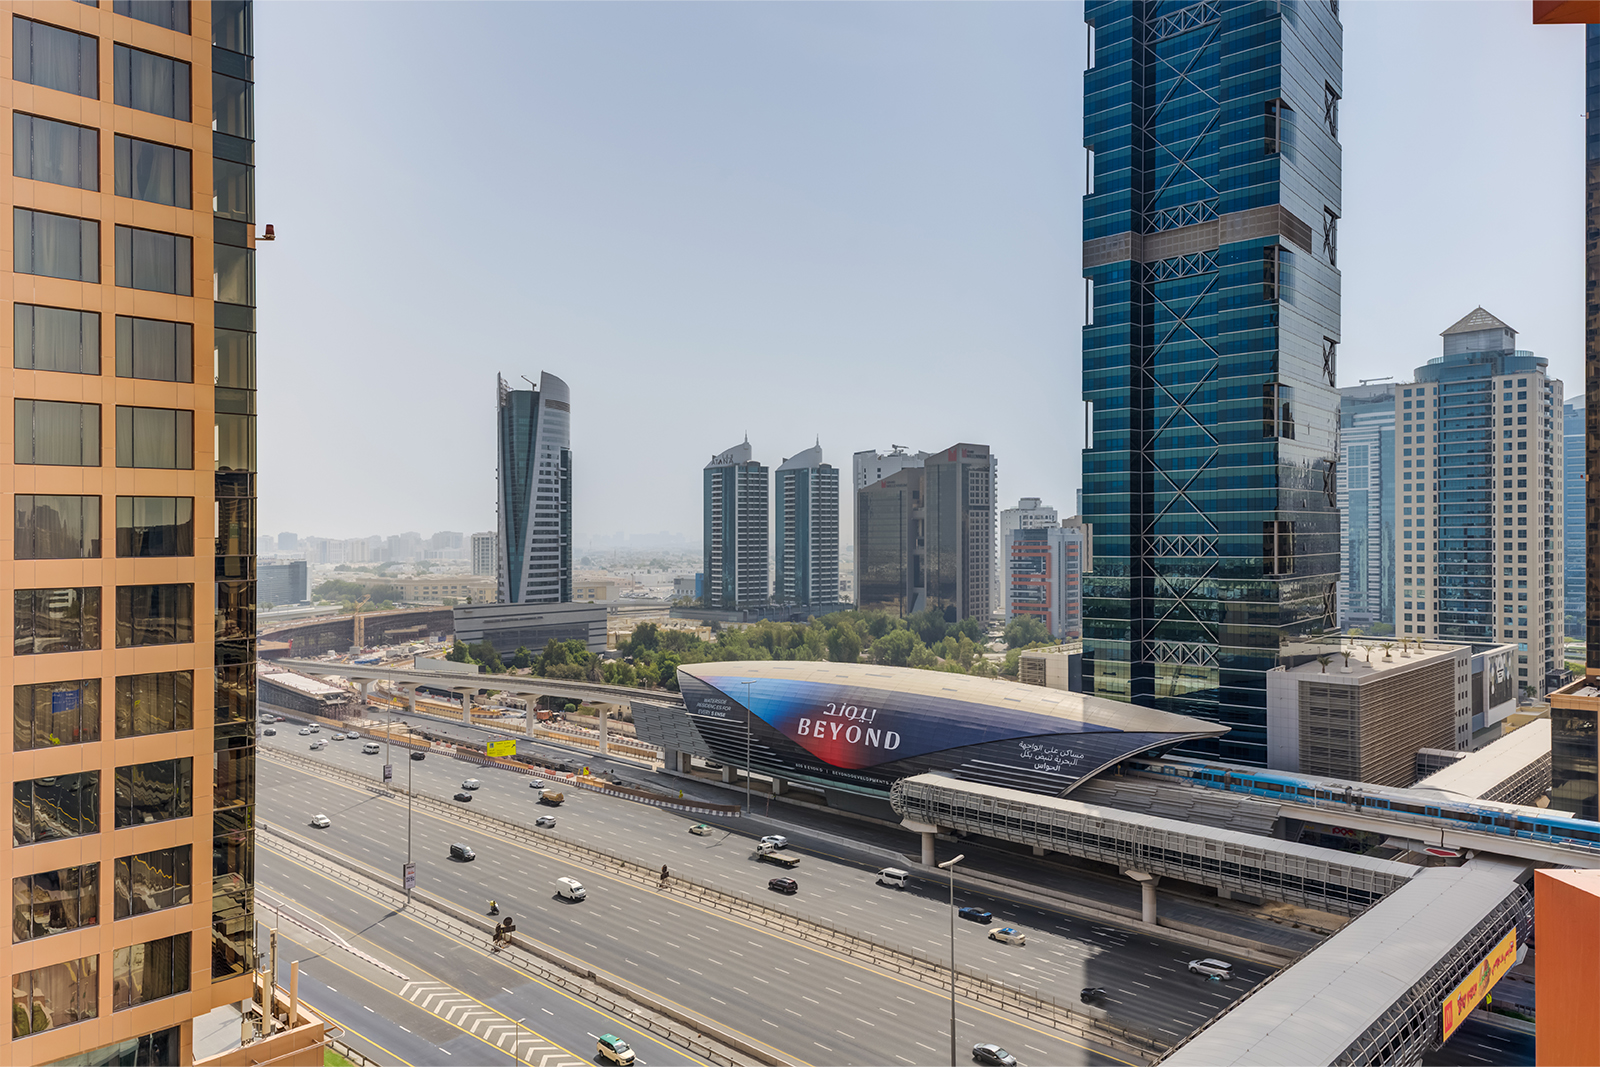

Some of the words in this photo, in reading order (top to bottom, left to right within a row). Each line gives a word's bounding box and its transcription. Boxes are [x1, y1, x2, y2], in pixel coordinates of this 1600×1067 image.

[711, 710, 726, 718] SENSE
[823, 702, 877, 724] بيوند
[797, 718, 901, 750] BEYOND
[1019, 741, 1043, 751] الواجهة
[1060, 750, 1084, 759] مساكن
[1054, 756, 1078, 766] البحرية
[1034, 763, 1060, 771] الحواس
